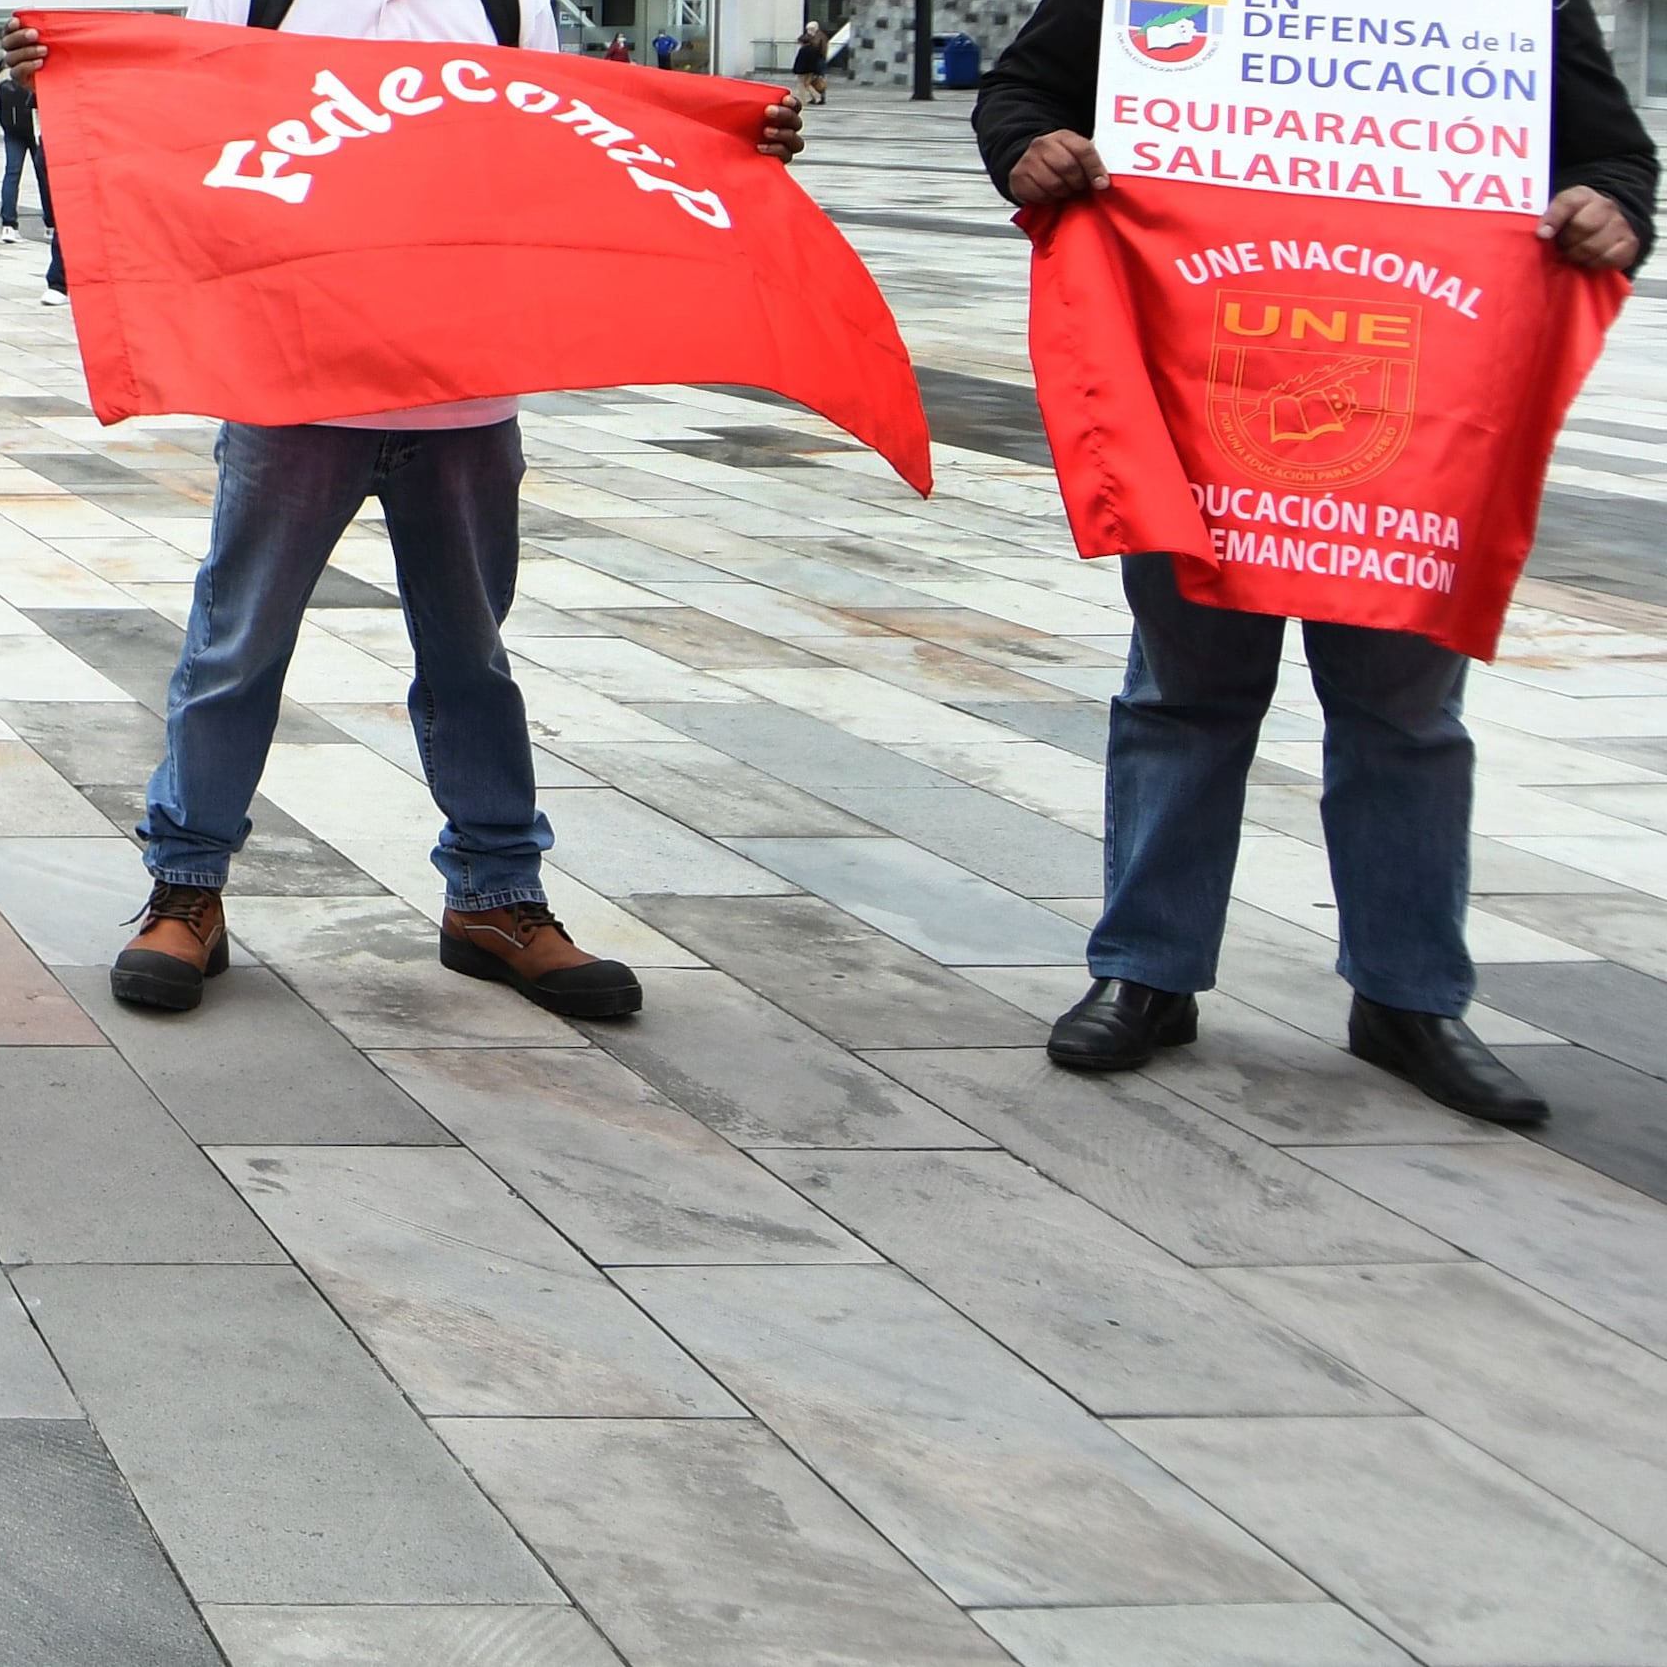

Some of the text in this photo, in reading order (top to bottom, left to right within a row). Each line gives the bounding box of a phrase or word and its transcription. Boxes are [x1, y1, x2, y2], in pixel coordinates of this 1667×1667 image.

[1243, 11, 1535, 52] DEFENSA de la
[1241, 52, 1536, 101] EDUCACIÓN
[202, 59, 731, 229] Fedecomip
[1114, 95, 1529, 159] EQUIPARACIÓN
[1132, 142, 1533, 210] SALARIAL YA!
[1174, 239, 1482, 320] UNE NACIONAL
[1223, 301, 1412, 348] UNE
[1219, 411, 1234, 433] POR
[1228, 435, 1245, 456] UNA
[1318, 467, 1352, 481] PARA
[1352, 459, 1366, 472] EL
[1366, 426, 1397, 463] PUEBLO
[1190, 483, 1460, 551] DUCACIÓN PARA
[1210, 527, 1457, 594] EMANCIPACIÓN
